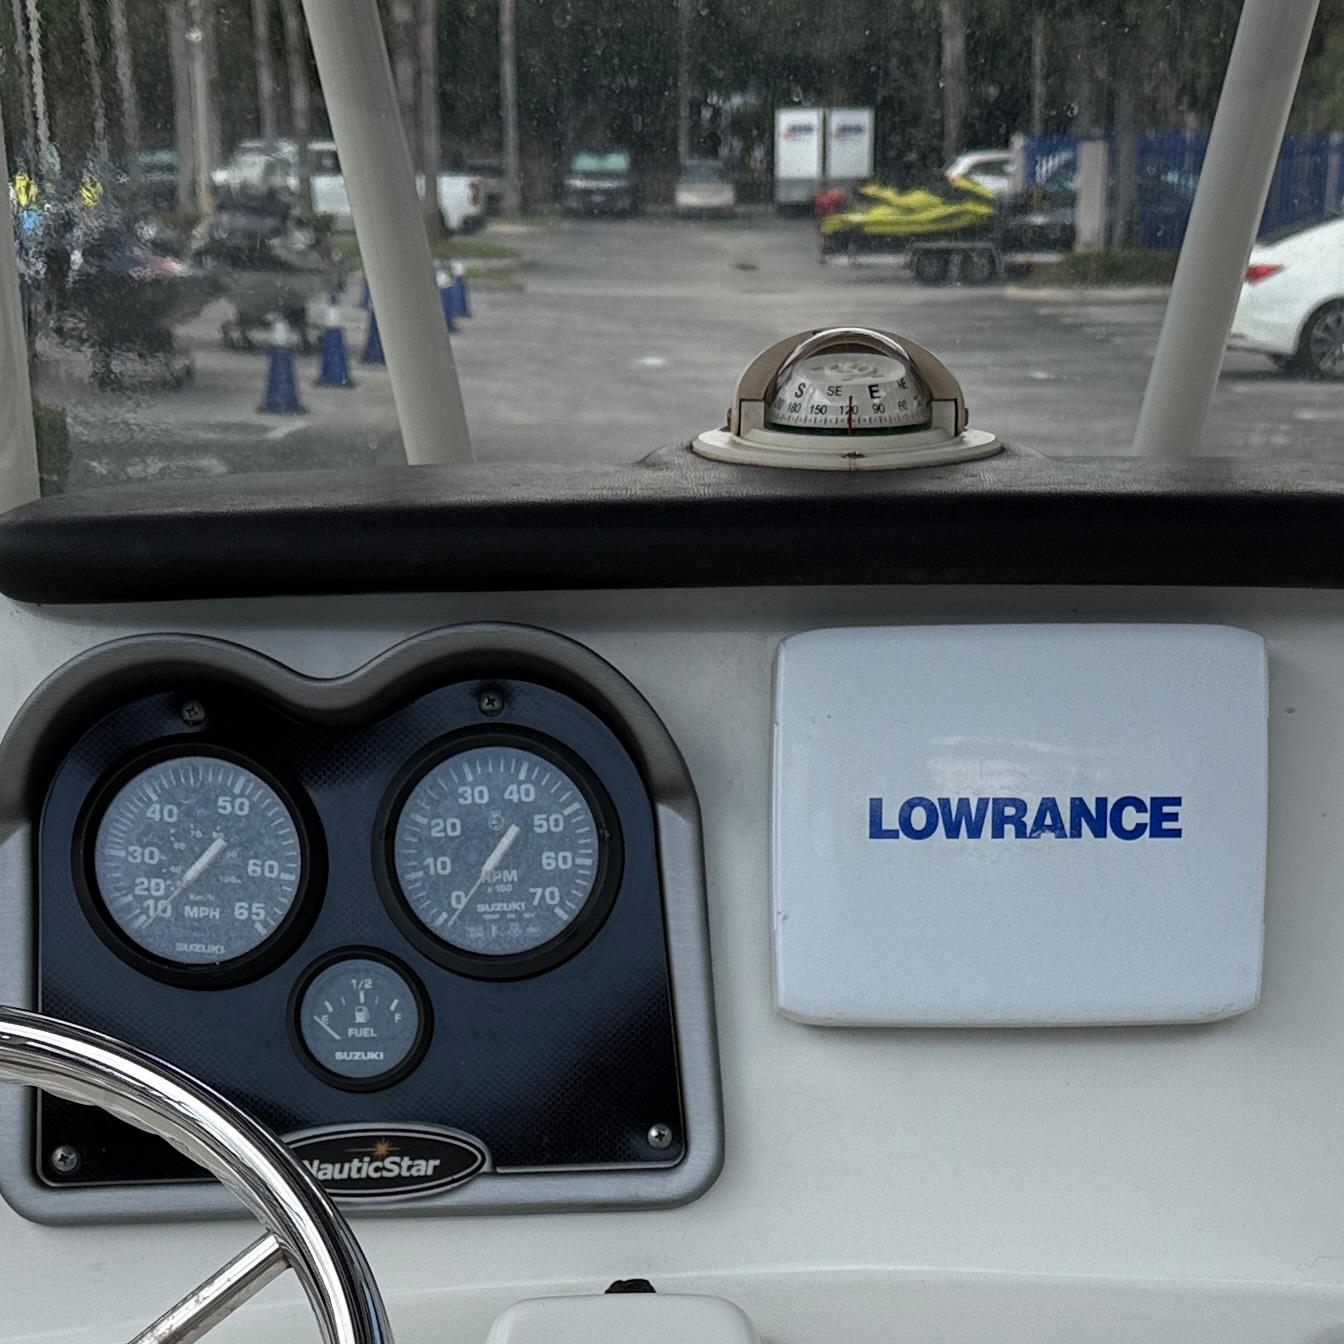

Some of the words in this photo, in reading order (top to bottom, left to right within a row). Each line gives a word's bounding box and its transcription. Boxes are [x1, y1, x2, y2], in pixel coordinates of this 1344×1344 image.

[794, 383, 806, 398] S
[826, 386, 843, 397] SE
[868, 385, 880, 399] E
[809, 404, 827, 415] 150
[872, 403, 885, 414] 90
[458, 785, 489, 804] 30
[504, 784, 536, 803] 40
[146, 803, 178, 822] 40
[217, 796, 249, 816] 50
[430, 818, 461, 837] 20
[533, 814, 564, 833] 50
[868, 796, 1183, 841] LOWRANCE
[127, 846, 159, 865] 30
[541, 851, 573, 870] 60
[247, 860, 279, 878] 60
[423, 856, 452, 876] 10
[134, 878, 164, 896] 20
[529, 886, 560, 906] 70
[143, 899, 172, 918] 10
[450, 890, 466, 909] 0
[476, 901, 526, 913] SUZUKI
[184, 905, 220, 919] MPH
[234, 902, 266, 920] 65
[175, 943, 224, 954] SUZUKI
[351, 978, 372, 990] 1/2
[394, 1013, 402, 1023] F
[348, 1027, 377, 1038] FUEL
[334, 1051, 384, 1061] SUZUKI
